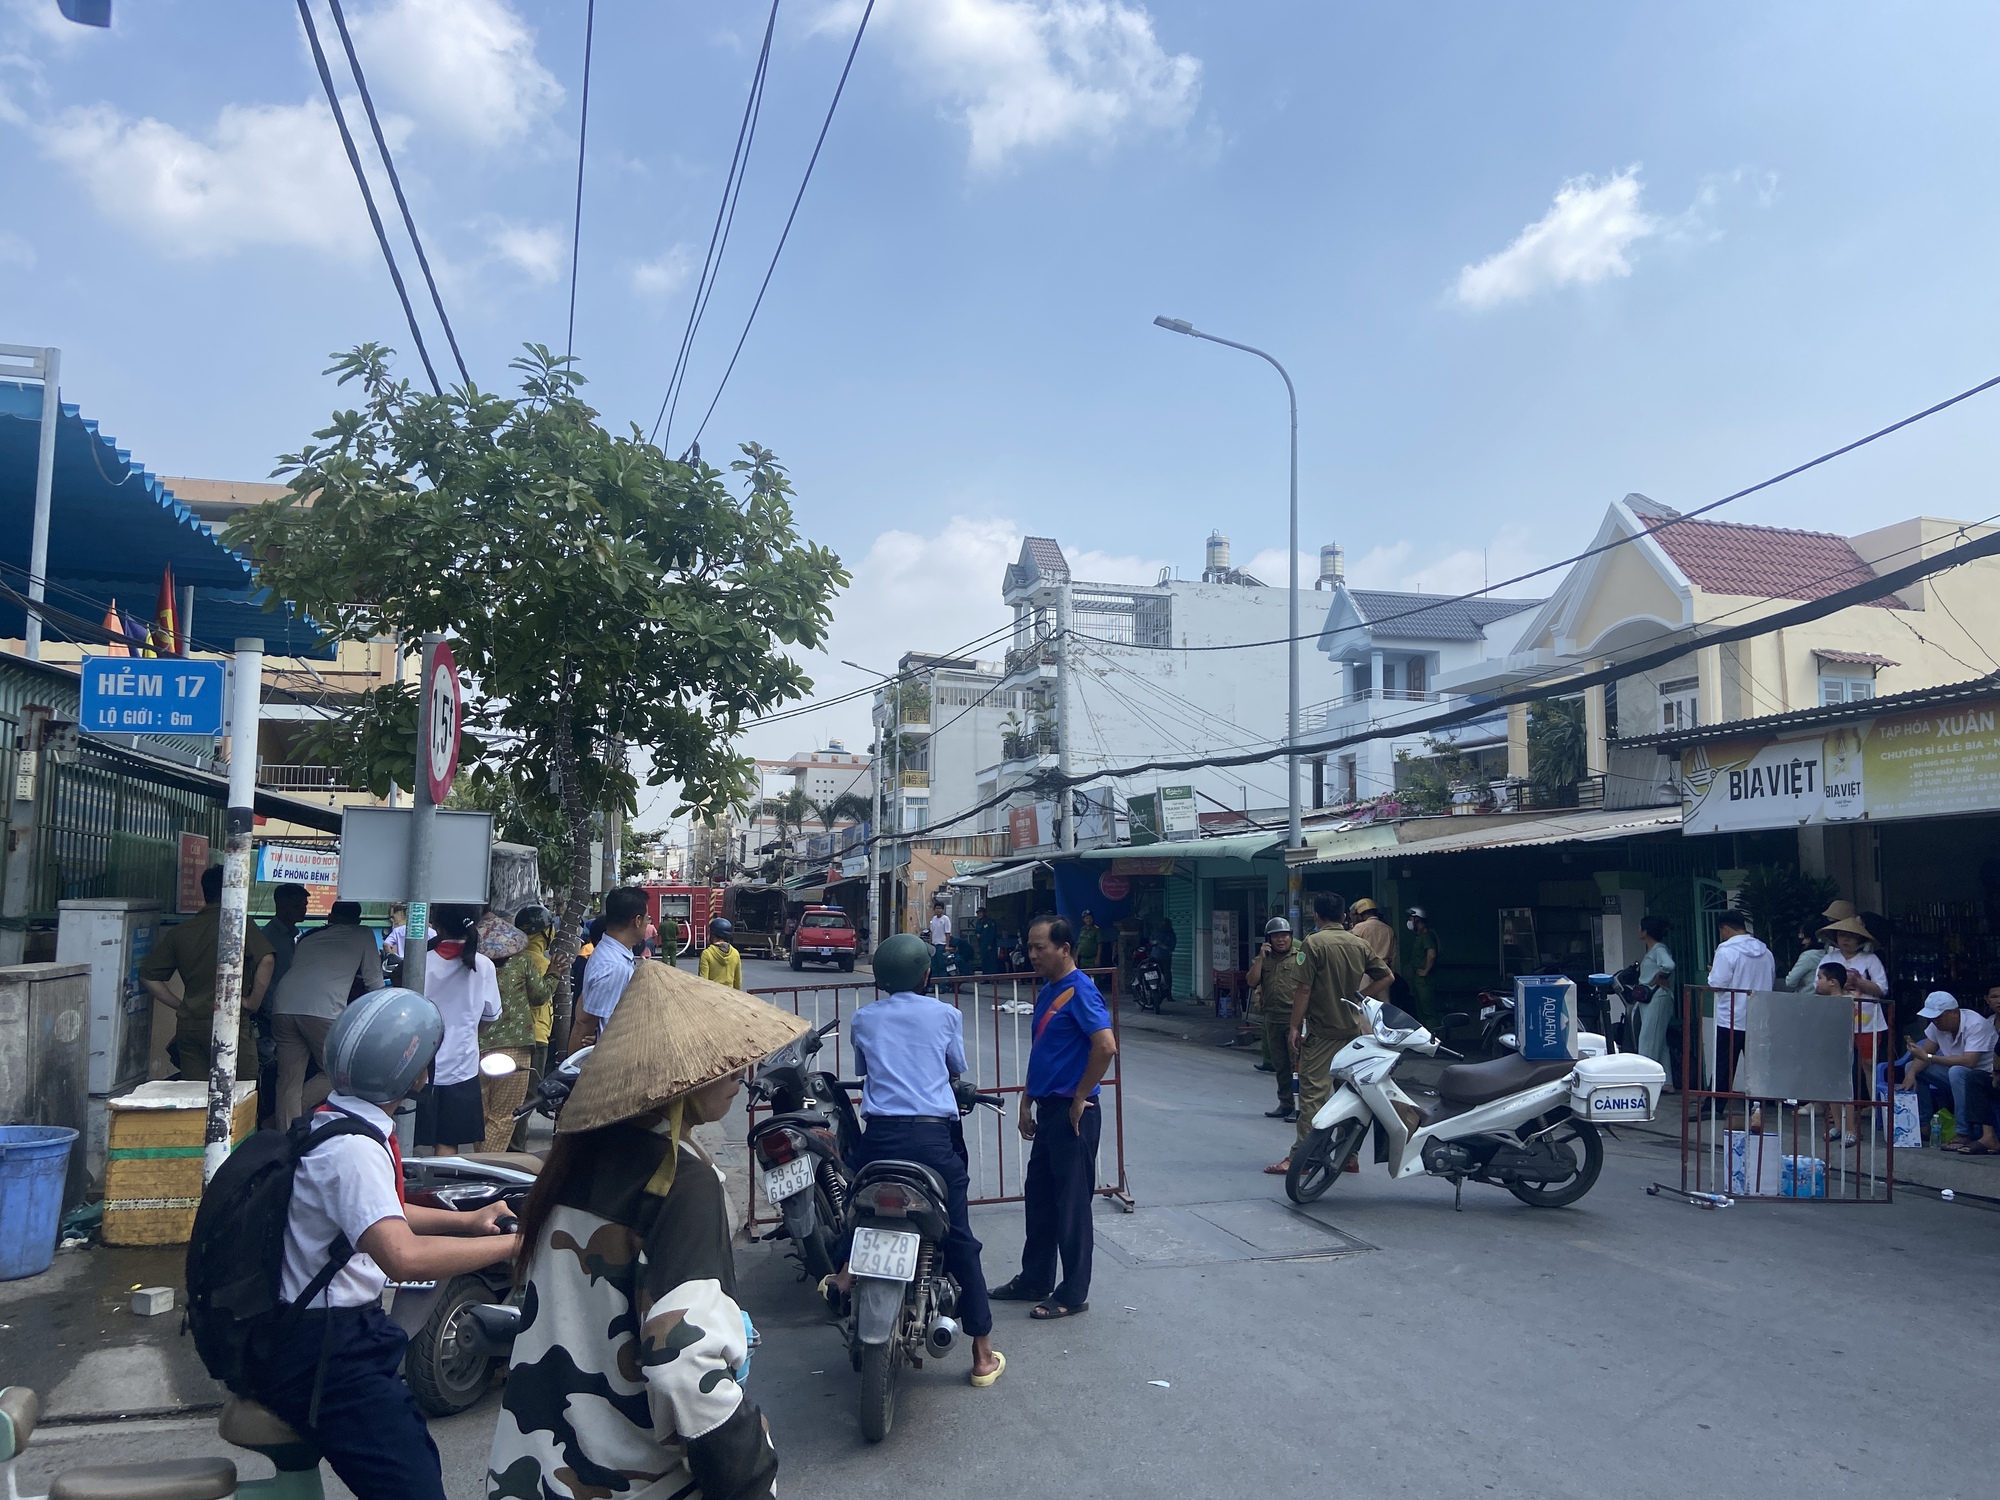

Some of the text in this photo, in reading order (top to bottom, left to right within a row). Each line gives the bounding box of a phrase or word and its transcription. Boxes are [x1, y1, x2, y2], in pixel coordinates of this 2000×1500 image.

[98, 666, 205, 698] HẺM 17
[99, 706, 117, 728] LỘ
[123, 707, 152, 725] GIỚI
[170, 712, 192, 726] 6m
[1880, 709, 1995, 740] TẠP HÓA XUÂN
[1880, 747, 1922, 760] CHUYÊN
[1966, 740, 1984, 750] BIA
[271, 850, 282, 862] TÌM
[296, 855, 310, 866] LOẠI
[273, 865, 283, 878] ĐỂ
[285, 868, 308, 880] PHÒNG
[311, 870, 329, 883] BỆNH
[1542, 996, 1557, 1048] AQUAFINA
[1594, 1095, 1647, 1110] CẢNH SÁ
[770, 1171, 809, 1200] 649.97
[863, 1232, 908, 1254] 54-Z8
[861, 1252, 906, 1277] 7946
